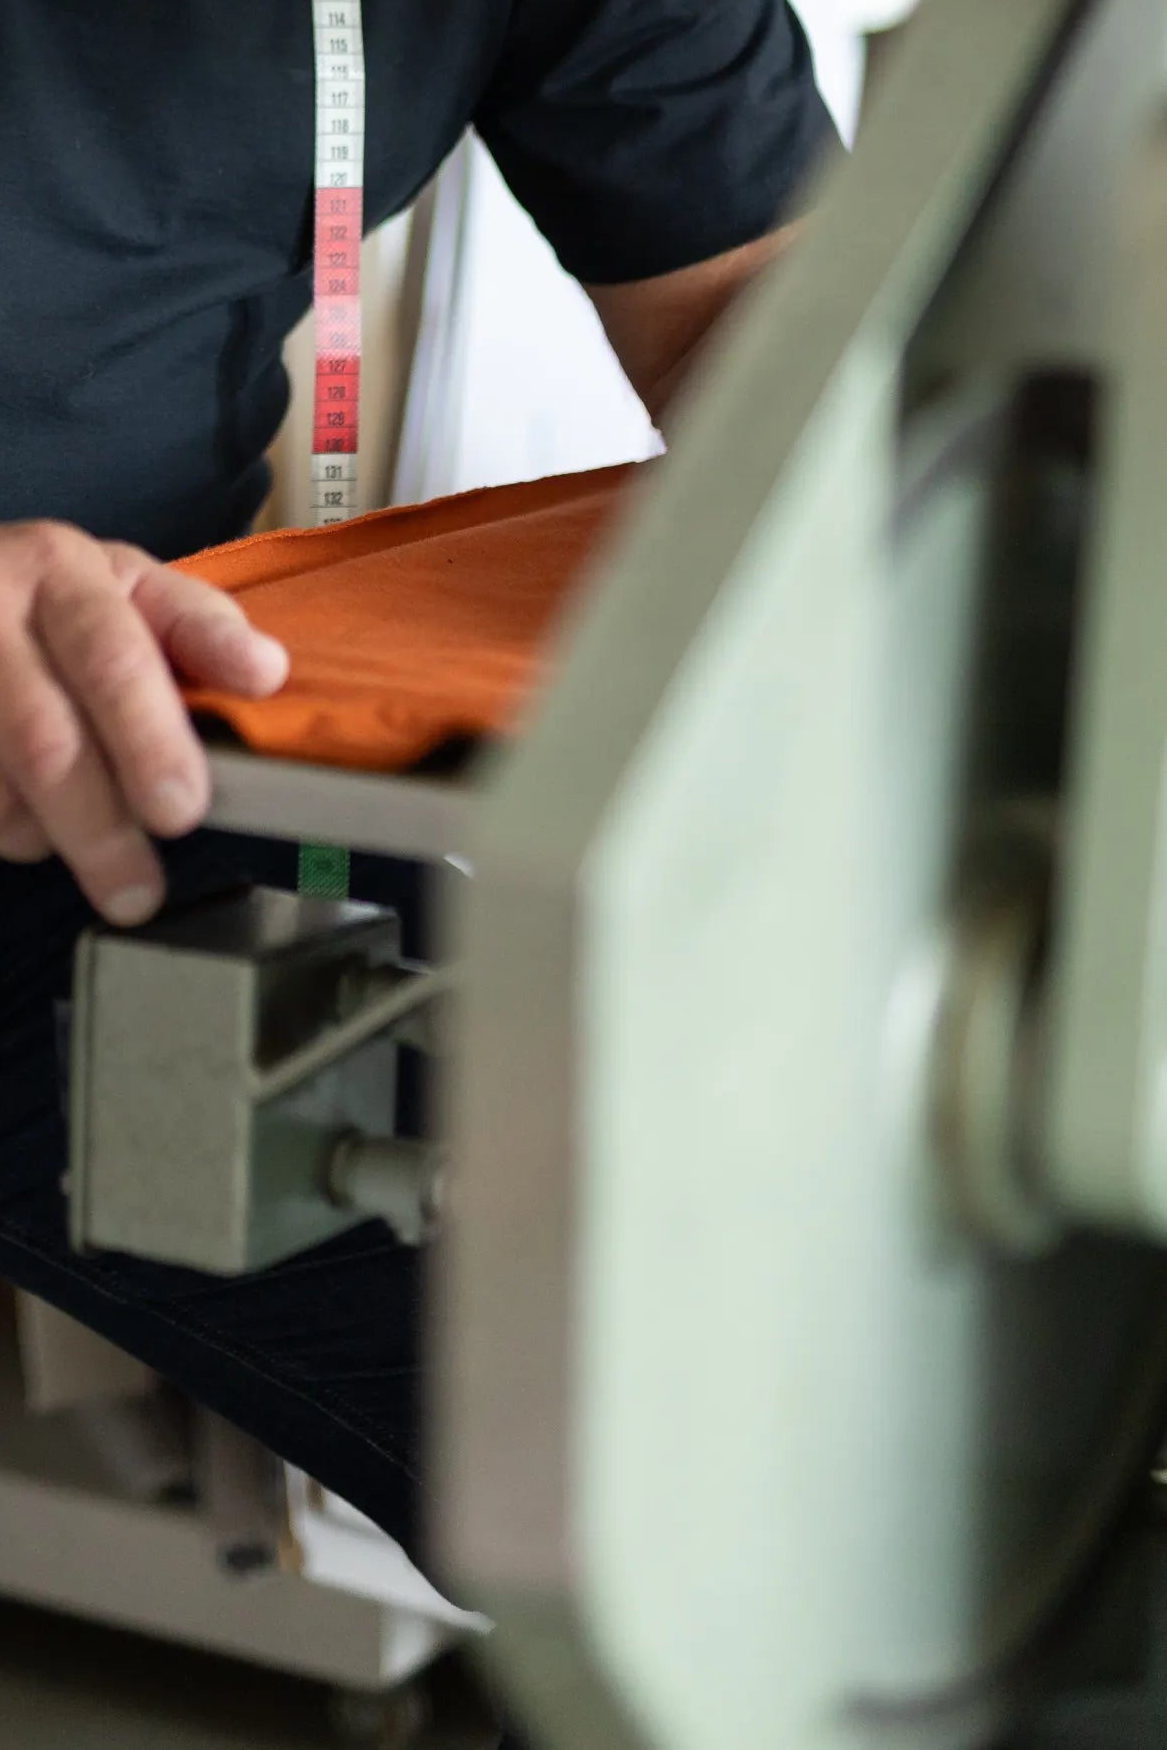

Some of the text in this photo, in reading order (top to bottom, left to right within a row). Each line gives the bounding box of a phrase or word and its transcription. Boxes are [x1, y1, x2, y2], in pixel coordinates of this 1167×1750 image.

[329, 13, 346, 27] 114
[332, 92, 349, 106] 117
[329, 360, 347, 373] 127
[325, 466, 342, 479] 131
[324, 492, 344, 506] 132
